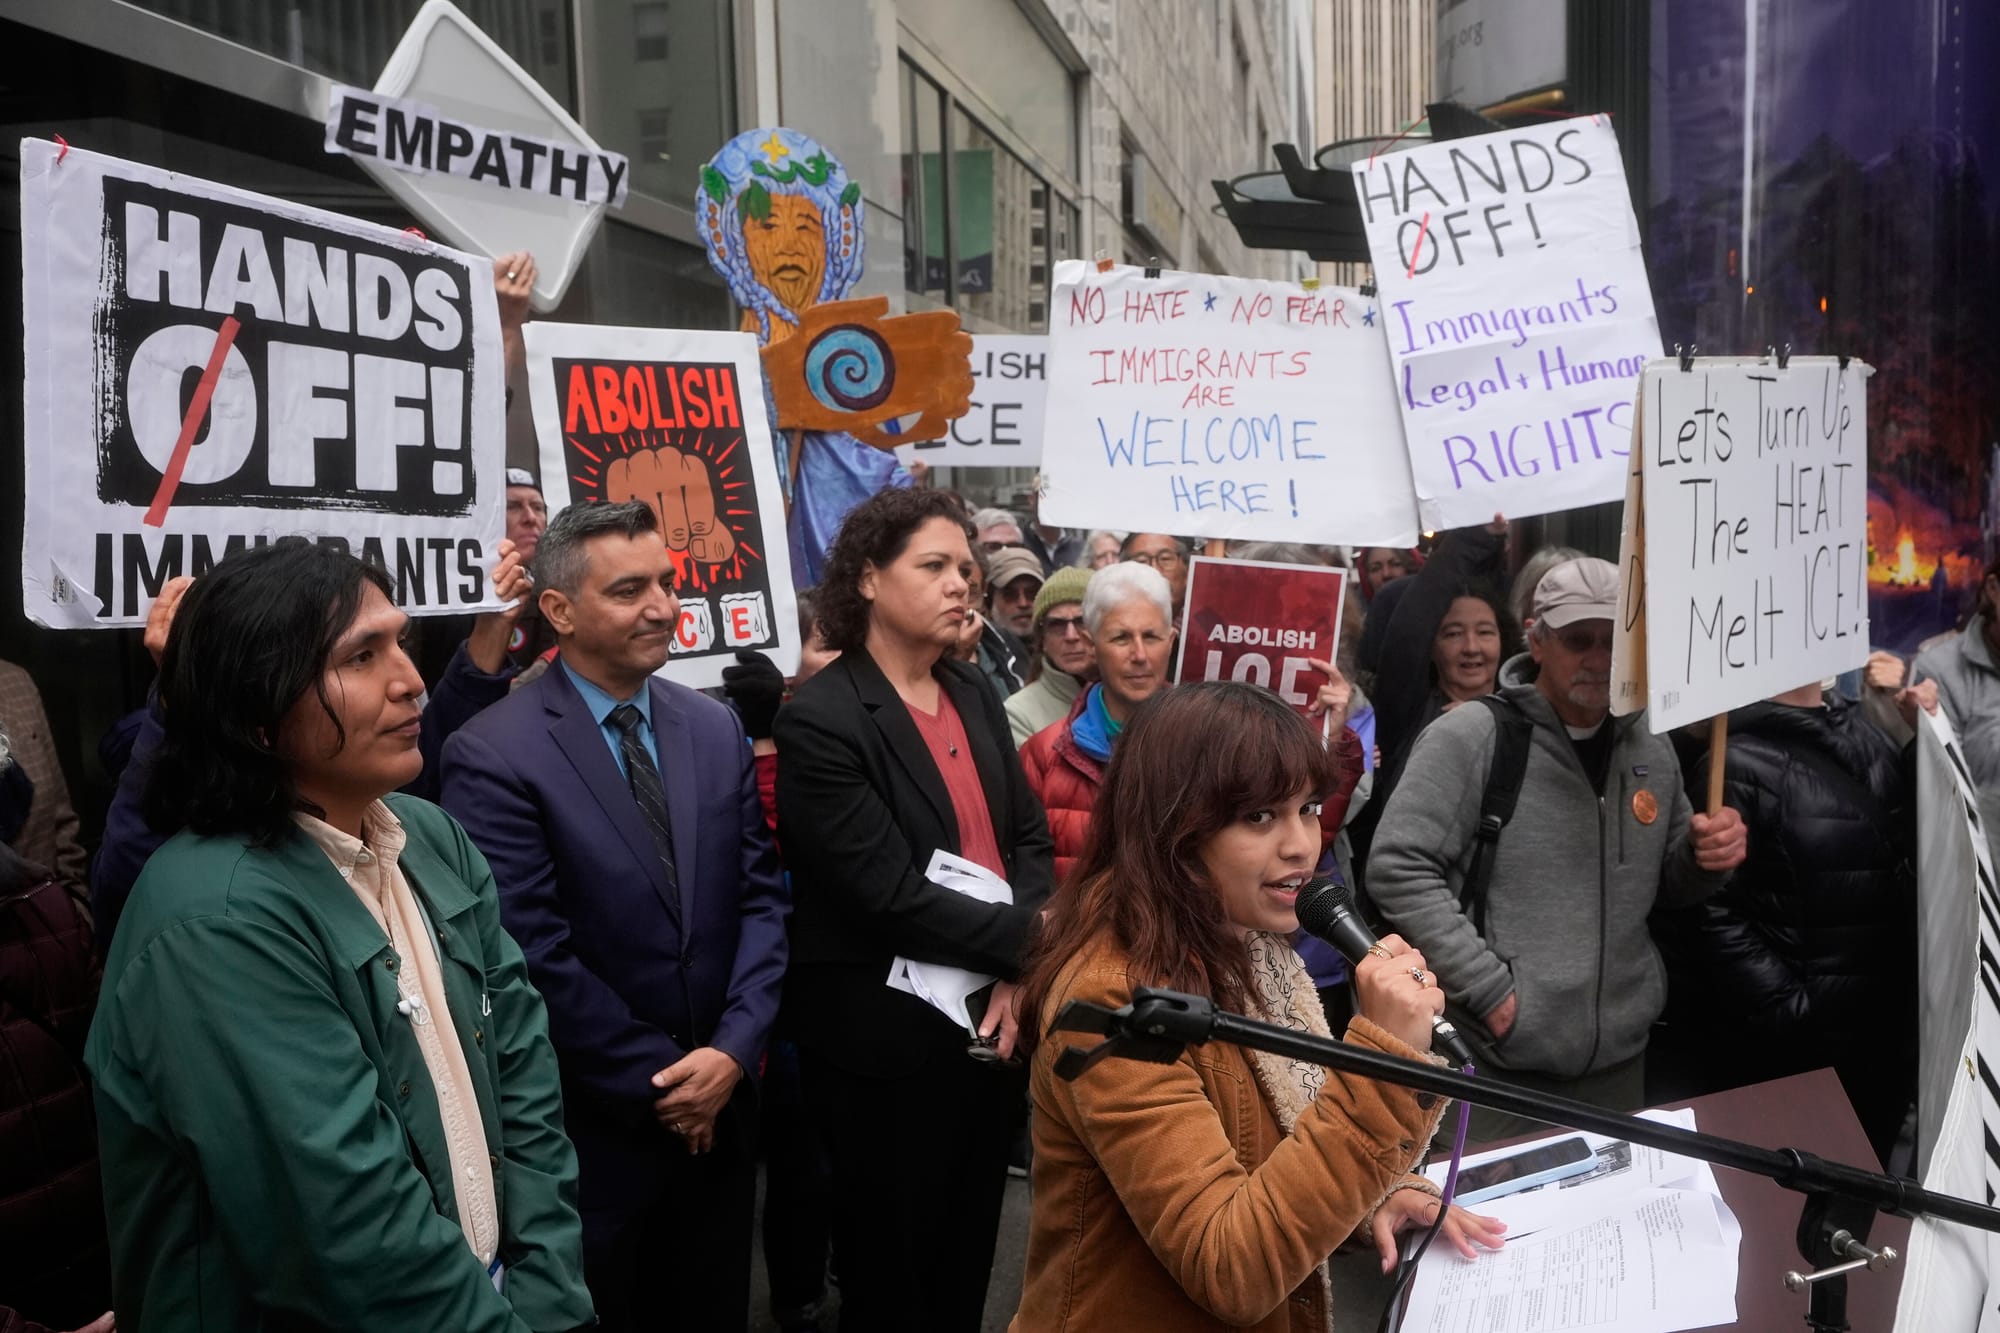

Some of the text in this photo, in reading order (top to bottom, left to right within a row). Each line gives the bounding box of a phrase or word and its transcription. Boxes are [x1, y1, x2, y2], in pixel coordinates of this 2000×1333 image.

[335, 95, 626, 204] EMPATHY
[1357, 129, 1592, 224] HANDS
[125, 201, 465, 351] HANDS
[1397, 202, 1547, 277] OFF!
[1070, 285, 1351, 329] NO HATE NO FEAR
[565, 365, 741, 435] ABOLISH
[1089, 346, 1312, 385] IMMIGRANTS
[1182, 383, 1235, 409] ARE
[1404, 356, 1512, 412] Legal
[126, 322, 466, 497] OFF!
[1097, 410, 1327, 468] WELCOME
[1443, 401, 1632, 490] RIGHTS
[1658, 366, 1852, 467] Let's Turn Up
[1679, 478, 1749, 570] The
[1774, 461, 1853, 549] HEAT
[1208, 623, 1317, 650] ABOLISH
[1686, 575, 1784, 685] Melt
[1803, 538, 1864, 650] ICE!
